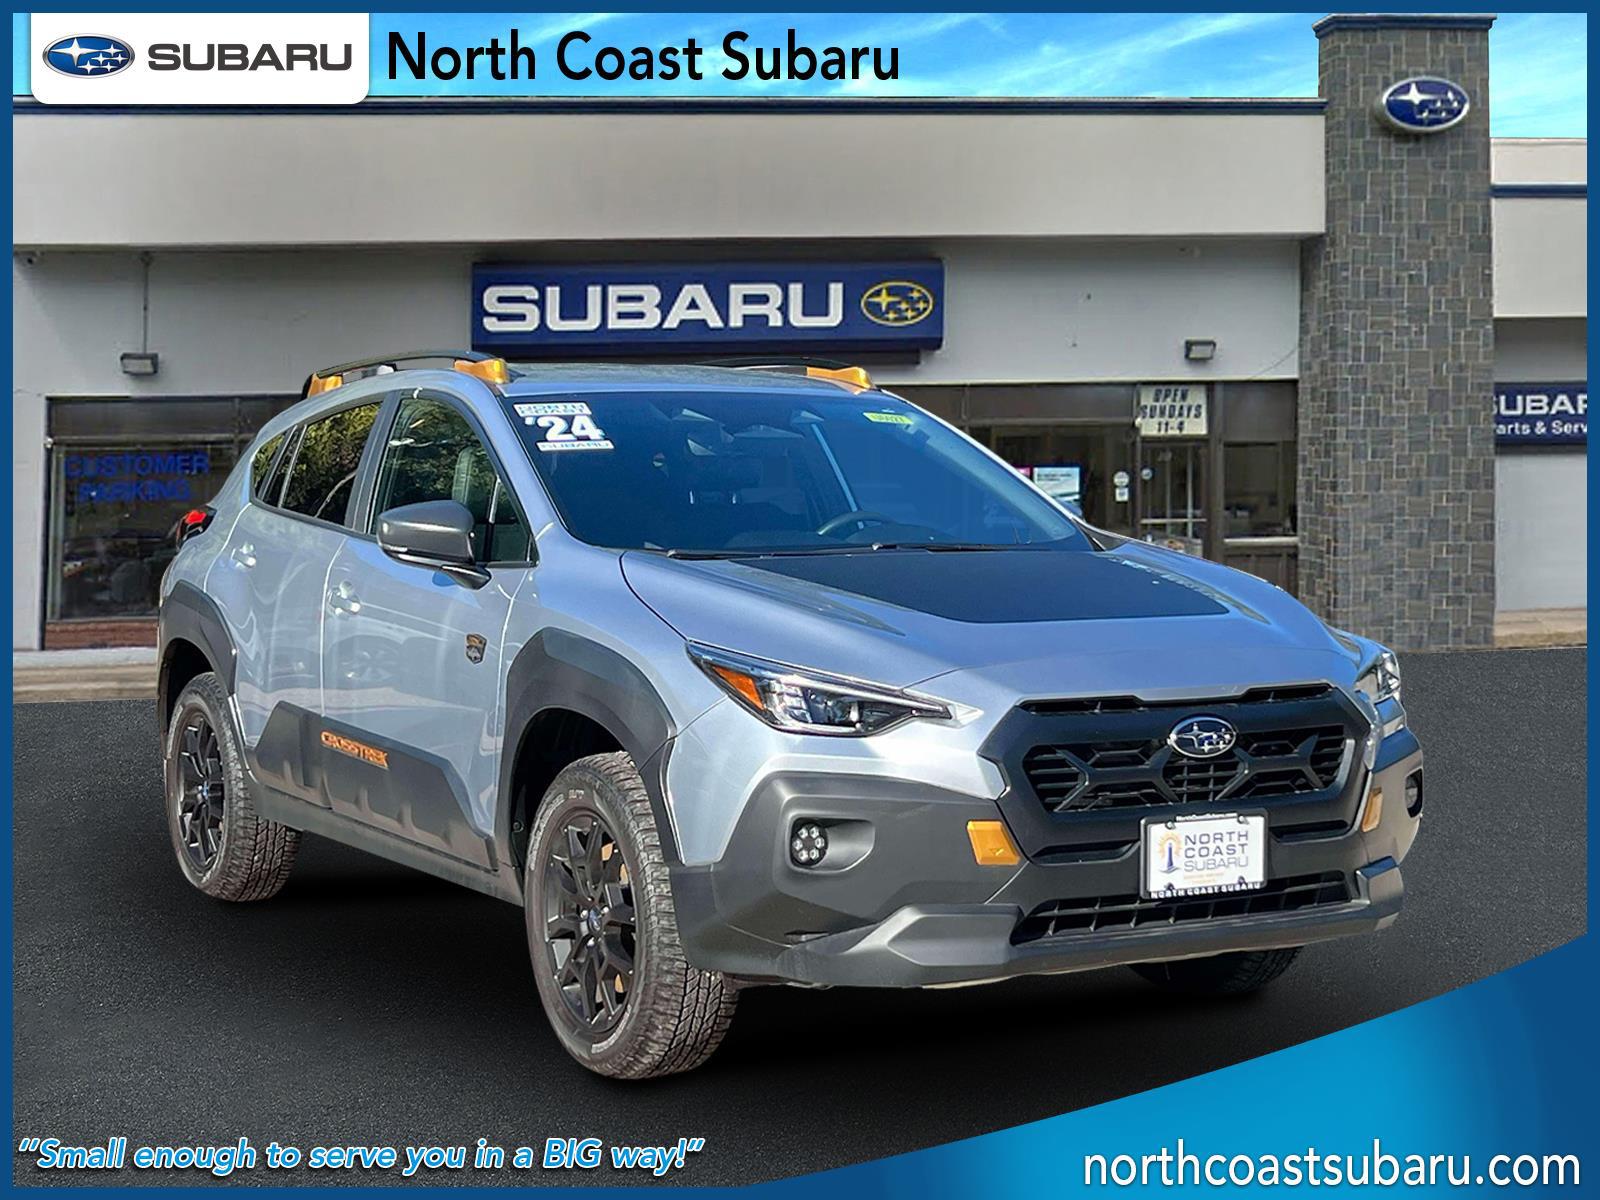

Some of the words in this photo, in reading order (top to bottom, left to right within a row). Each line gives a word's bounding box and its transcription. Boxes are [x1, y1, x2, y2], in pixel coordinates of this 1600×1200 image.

[482, 282, 843, 333] SUBARU
[1153, 388, 1189, 402] OPEN
[1140, 404, 1202, 419] SUNDAYS
[1493, 393, 1587, 416] UBA
[524, 414, 605, 441] '24
[1157, 421, 1184, 433] 11-4
[1493, 421, 1532, 435] arts
[1534, 420, 1547, 435] &
[66, 453, 209, 477] CUSTOMER
[320, 731, 389, 768] CROSSTREK
[1184, 831, 1249, 846] NORTH
[1184, 843, 1249, 859] COAST
[1183, 856, 1249, 872] SUBARU
[1151, 888, 1185, 899] NORTH
